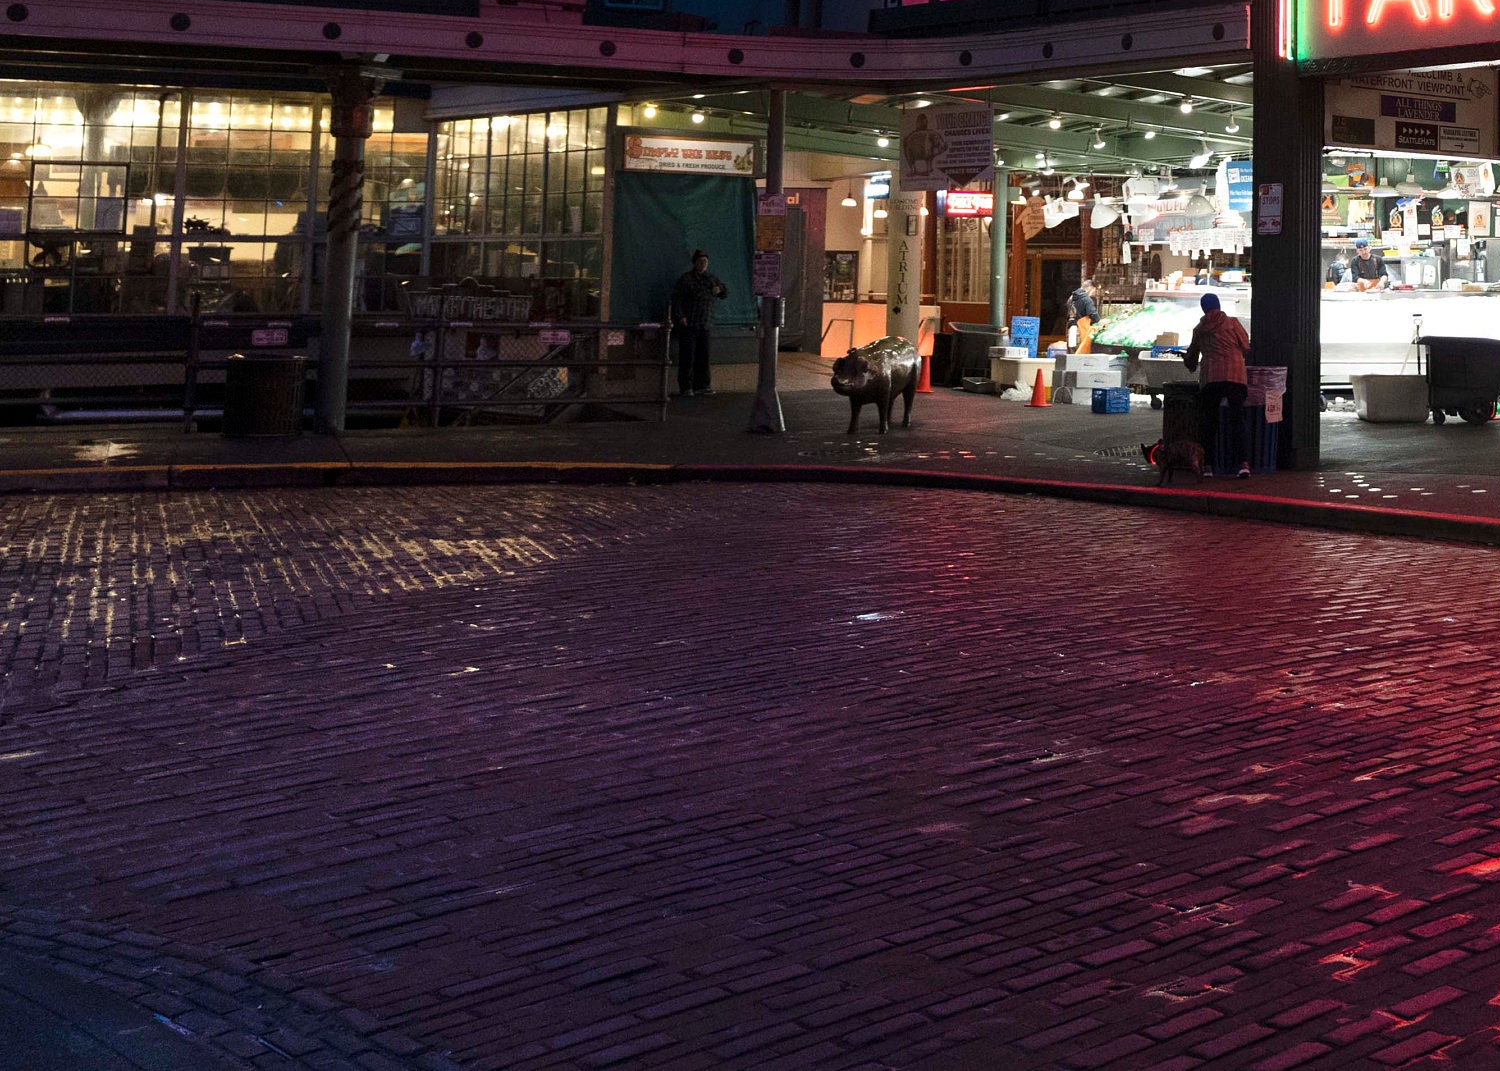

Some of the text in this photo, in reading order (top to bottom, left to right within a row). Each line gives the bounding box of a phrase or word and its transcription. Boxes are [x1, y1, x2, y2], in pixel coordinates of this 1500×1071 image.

[1418, 82, 1466, 96] VIEWPOINT
[1396, 98, 1442, 110] ALL THINGS
[1398, 108, 1440, 121] LAVENDER
[1262, 196, 1280, 205] STOPS
[896, 240, 909, 305] ATRIUM
